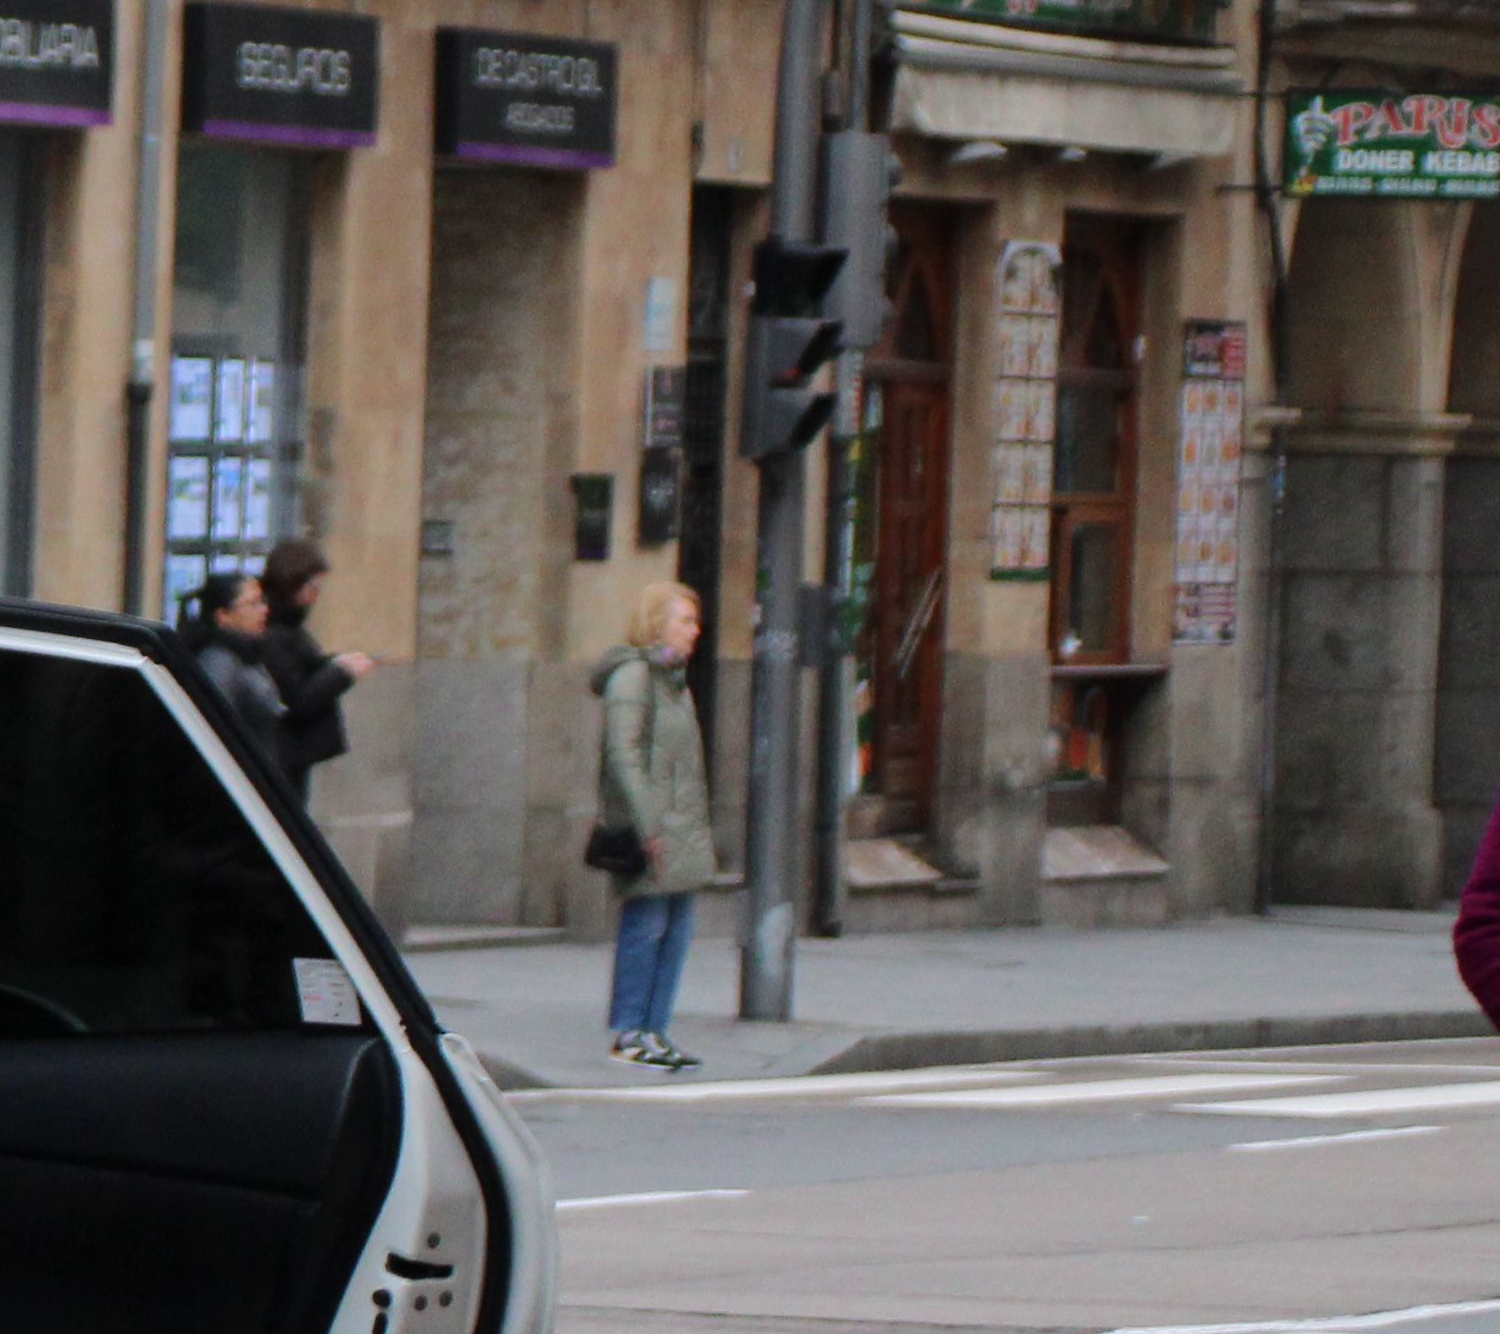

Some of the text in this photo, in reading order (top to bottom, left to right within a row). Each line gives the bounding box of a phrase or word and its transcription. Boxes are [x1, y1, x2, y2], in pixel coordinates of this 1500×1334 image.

[237, 40, 351, 95] SEGUROS
[1328, 94, 1500, 150] PARIS
[1334, 149, 1416, 174] DONER
